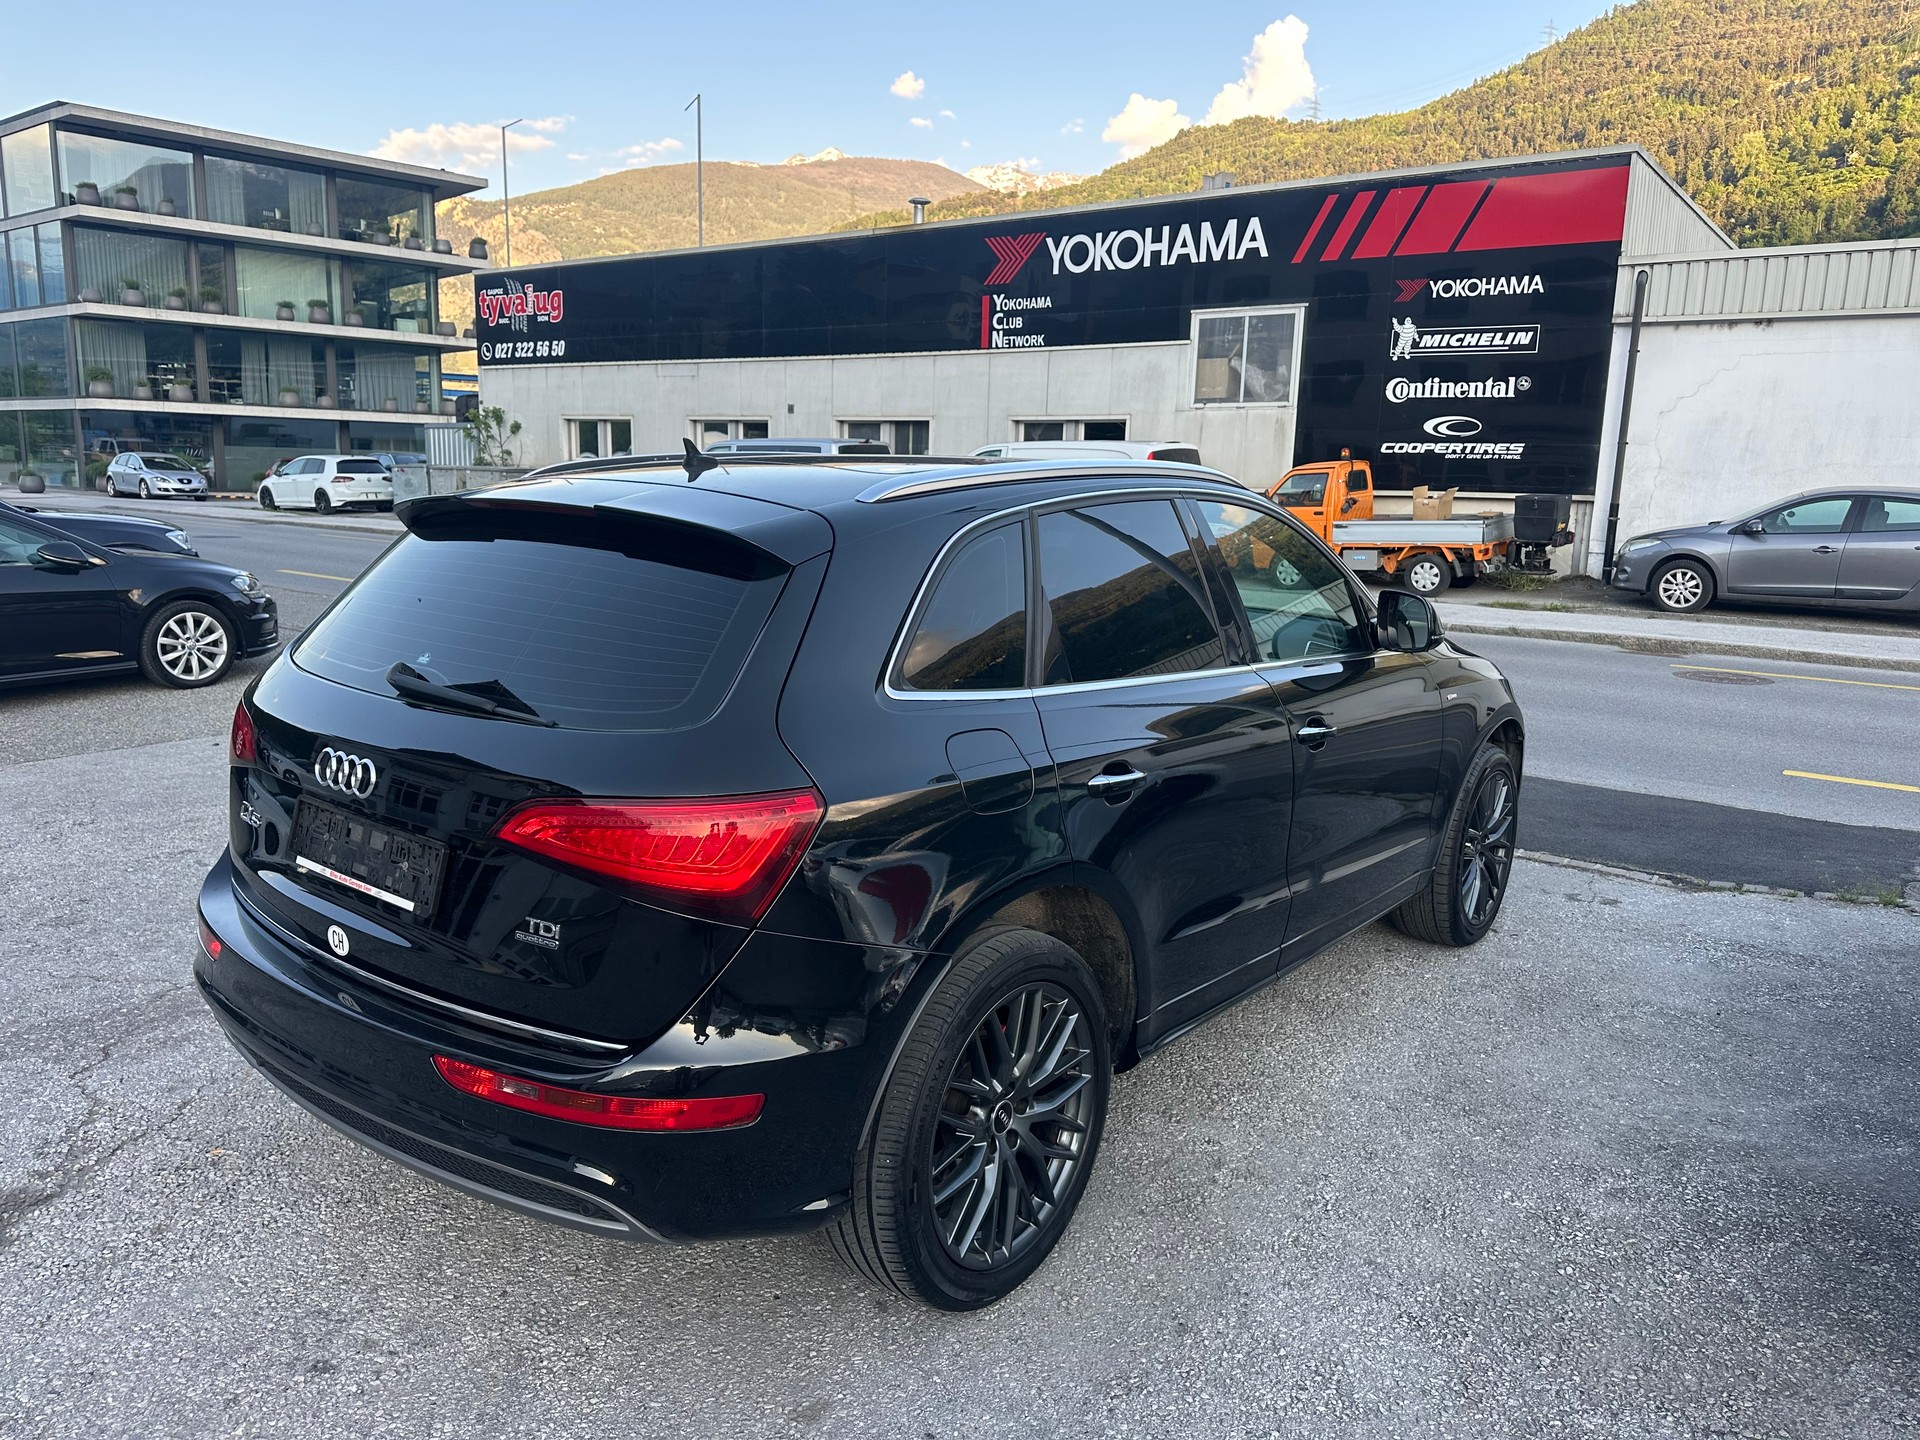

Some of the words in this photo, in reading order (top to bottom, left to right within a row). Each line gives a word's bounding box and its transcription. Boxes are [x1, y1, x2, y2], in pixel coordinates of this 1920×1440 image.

[1045, 216, 1269, 275] YOKOHAMA
[1429, 274, 1545, 299] YOKOHAMA
[992, 293, 1052, 311] YOKOHAMA
[991, 330, 1045, 348] NETWORK
[1418, 331, 1534, 348] MICHELIN
[494, 342, 514, 359] 027
[514, 341, 534, 358] 322
[535, 340, 550, 357] 56
[551, 340, 566, 356] 50
[1385, 376, 1516, 403] Continental
[525, 916, 561, 940] TDI
[332, 930, 344, 951] CH
[516, 933, 556, 948] quattro
